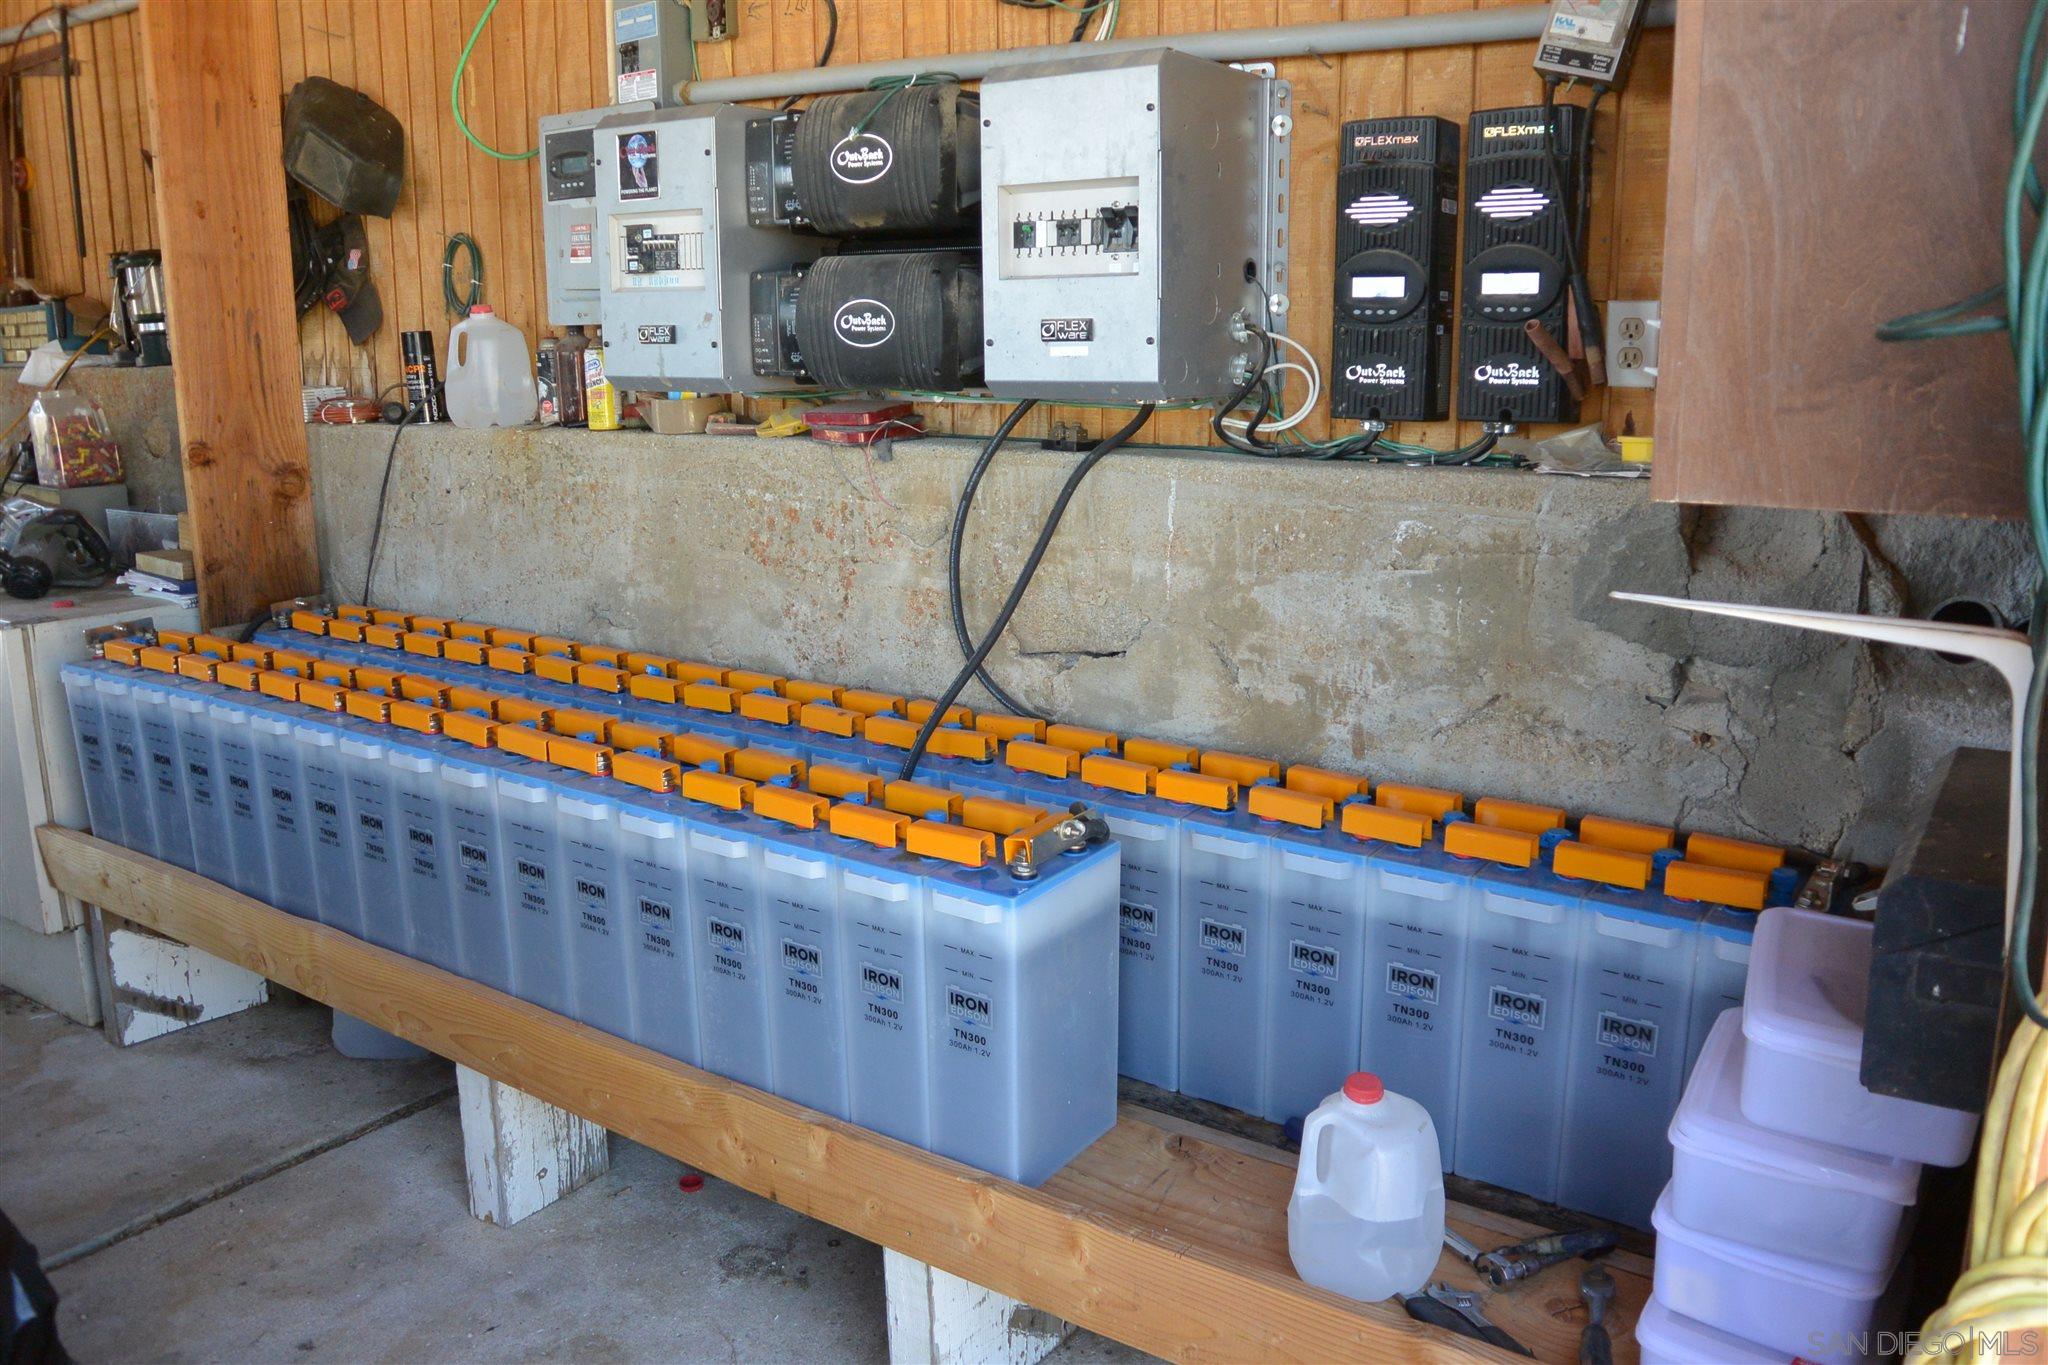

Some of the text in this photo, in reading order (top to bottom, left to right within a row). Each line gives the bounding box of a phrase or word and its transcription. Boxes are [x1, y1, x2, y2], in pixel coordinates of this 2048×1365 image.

[1555, 16, 1576, 28] KAL
[837, 147, 884, 166] OutBack
[841, 312, 886, 329] OutBack
[1057, 320, 1087, 331] FLEX
[649, 326, 671, 336] FLEX
[867, 325, 887, 333] Systems
[1346, 363, 1405, 380] OutBack
[1474, 363, 1540, 381] OutBack
[1359, 376, 1405, 386] Power Systems
[1488, 376, 1539, 386] Power Systems
[315, 801, 336, 815] IRON
[361, 814, 383, 830] IRON
[409, 829, 433, 845] IRON
[462, 846, 486, 861] IRON
[518, 862, 545, 879] IRON
[577, 881, 605, 899] IRON
[641, 901, 670, 920] IRON
[582, 912, 606, 926] TN300
[711, 922, 742, 941] IRON
[1204, 924, 1242, 943] IRON
[645, 933, 671, 947] TN300
[1121, 936, 1151, 951] TN300
[1204, 936, 1241, 951] EDISON
[715, 954, 742, 969] TN300
[784, 944, 818, 964] IRON
[1294, 946, 1334, 966] IRON
[786, 957, 819, 973] EDISON
[1201, 967, 1225, 978] 300Ah
[1206, 957, 1239, 972] TN300
[1294, 959, 1334, 975] EDISON
[789, 977, 818, 993] TN300
[864, 968, 899, 990] IRON
[1392, 968, 1434, 990] IRON
[785, 989, 806, 1000] 300Ah
[864, 981, 899, 999] EDISON
[1296, 979, 1330, 996] TN300
[1391, 982, 1434, 999] EDISON
[950, 992, 988, 1015] IRON
[1290, 990, 1315, 1003] 300Ah
[1494, 992, 1540, 1015] IRON
[868, 1003, 898, 1020] TN300
[951, 1006, 989, 1024] EDISON
[1393, 1003, 1430, 1020] TN300
[1494, 1006, 1539, 1024] EDISON
[864, 1014, 885, 1026] 300Ah
[1387, 1015, 1412, 1027] 300Ah
[953, 1028, 987, 1046] TN300
[1495, 1028, 1534, 1046] TN300
[1603, 1018, 1652, 1041] IRON
[949, 1039, 973, 1052] 300Ah
[1489, 1040, 1516, 1052] 300Ah
[1602, 1031, 1651, 1050] EDISON
[1603, 1055, 1645, 1073] TN300
[1596, 1066, 1626, 1080] 300Ah
